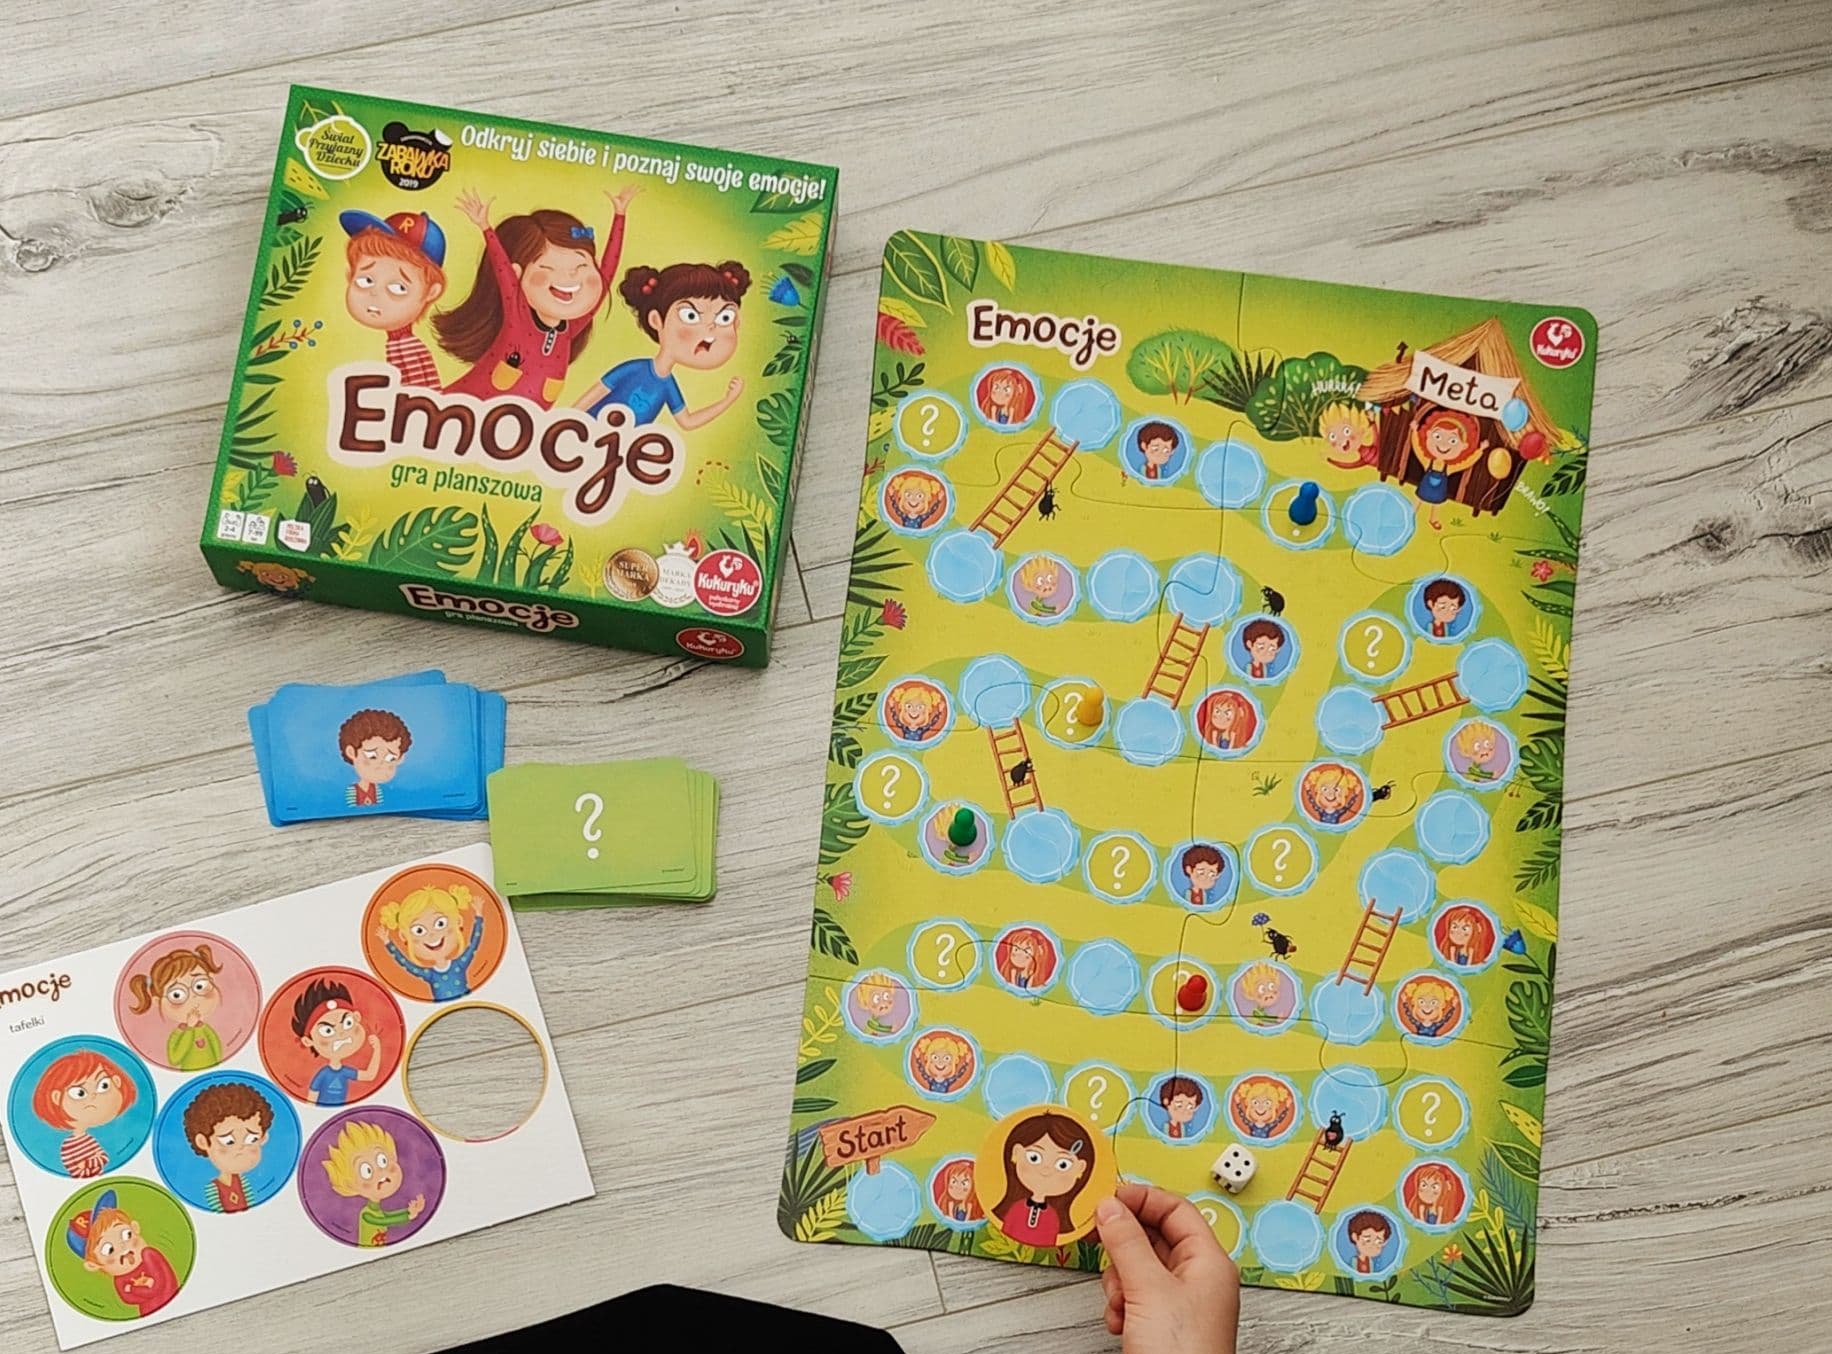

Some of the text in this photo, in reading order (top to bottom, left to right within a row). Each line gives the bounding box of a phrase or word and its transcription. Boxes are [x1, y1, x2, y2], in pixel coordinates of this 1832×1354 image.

[309, 137, 364, 159] Przyjazny
[316, 150, 361, 167] Dziecku
[377, 143, 450, 171] ZABAWKA
[461, 125, 827, 203] Odkryj siebie i poznaj swoje emocje!
[390, 159, 435, 179] ROKU
[398, 177, 419, 188] 2019
[973, 304, 1117, 366] Emocje
[1419, 366, 1499, 411] Meta
[339, 374, 675, 515] Emocje
[391, 463, 543, 502] gra planszowa
[406, 586, 574, 630] Emocje
[0, 973, 73, 1009] mocje
[9, 1016, 46, 1033] tafelki
[836, 1114, 908, 1159] Start
